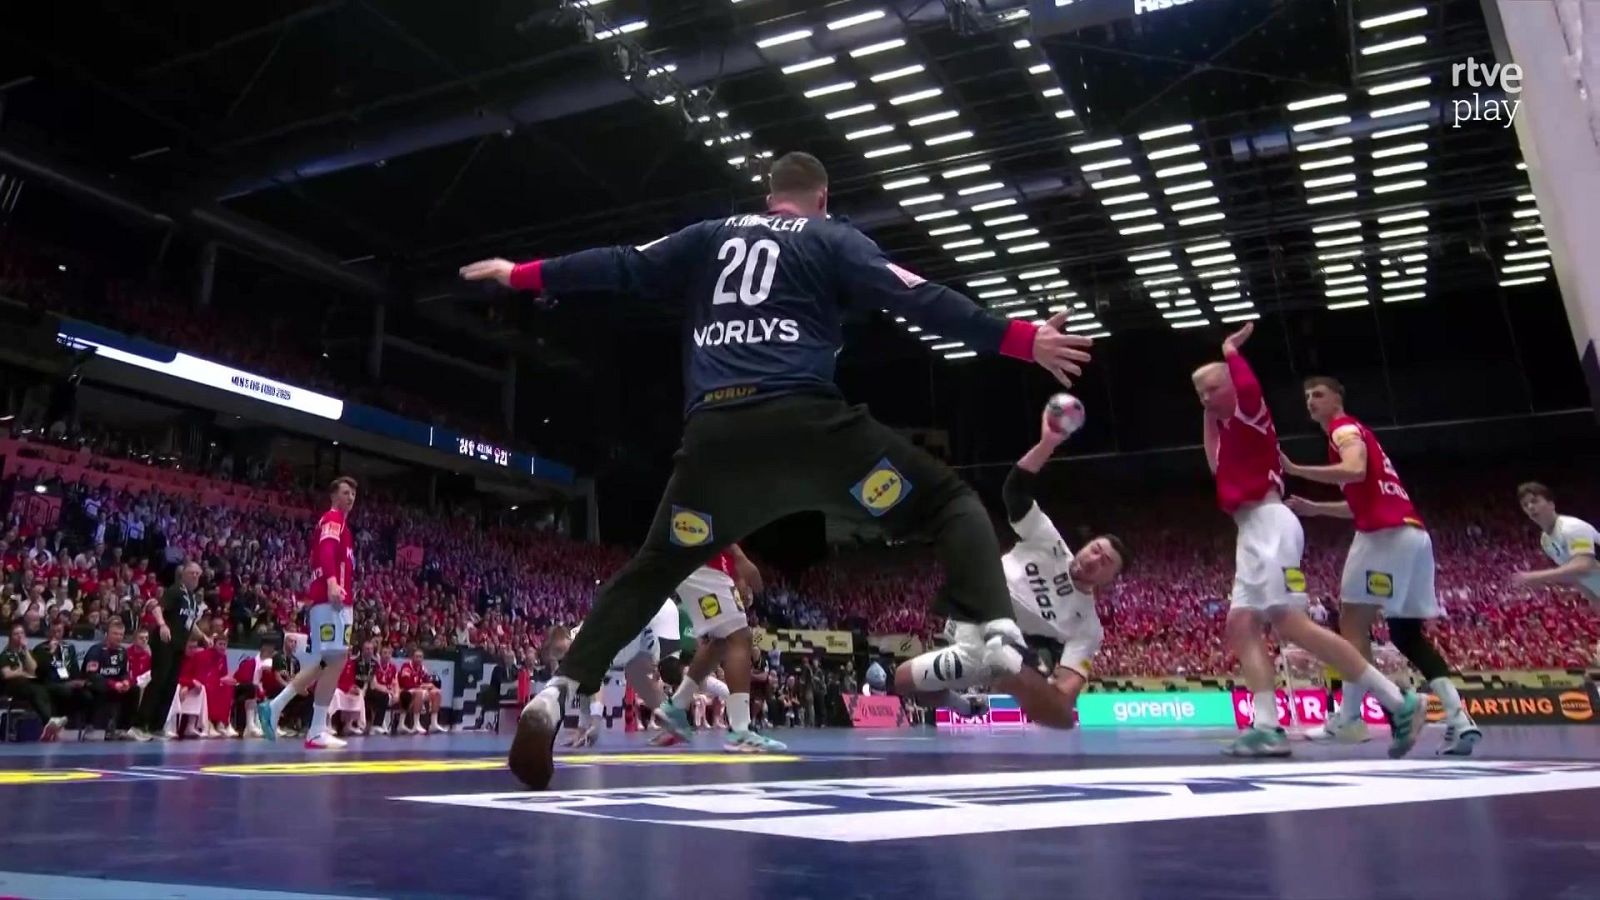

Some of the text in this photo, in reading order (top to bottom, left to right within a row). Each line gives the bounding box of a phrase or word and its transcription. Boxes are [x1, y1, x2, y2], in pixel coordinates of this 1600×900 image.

[712, 237, 781, 306] 20
[1025, 563, 1057, 621] atlas
[1113, 698, 1195, 721] gorenje
[1462, 698, 1554, 715] ARTING
